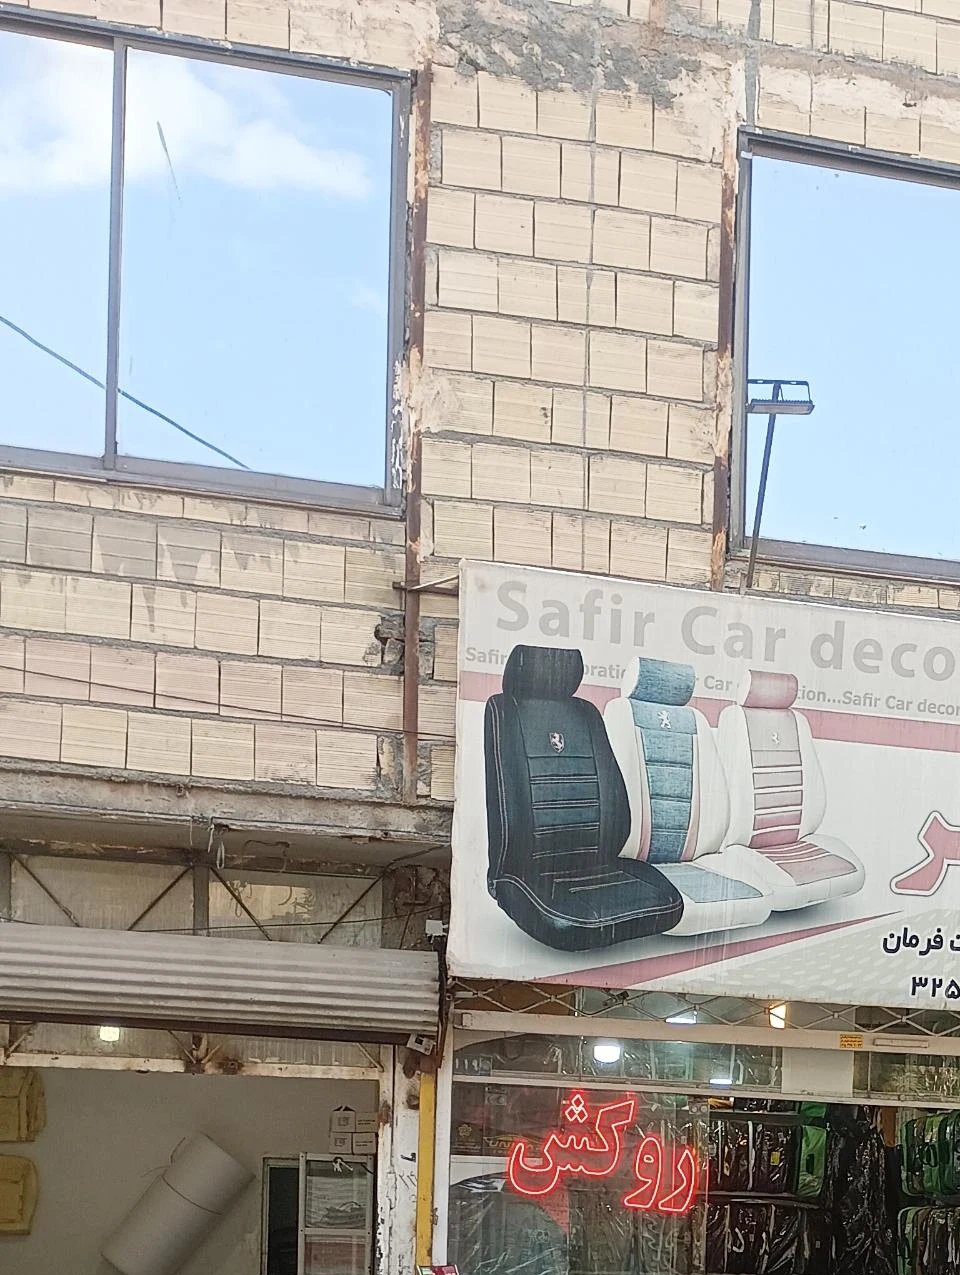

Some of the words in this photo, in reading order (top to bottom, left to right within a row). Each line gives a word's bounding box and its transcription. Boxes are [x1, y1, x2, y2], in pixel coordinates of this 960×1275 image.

[496, 581, 655, 647] Safir
[681, 607, 786, 663] Car
[465, 647, 508, 665] Safir
[704, 676, 733, 691] Car
[885, 695, 913, 712] Car
[882, 927, 944, 956] فرمان
[509, 1092, 696, 1213] روکش
